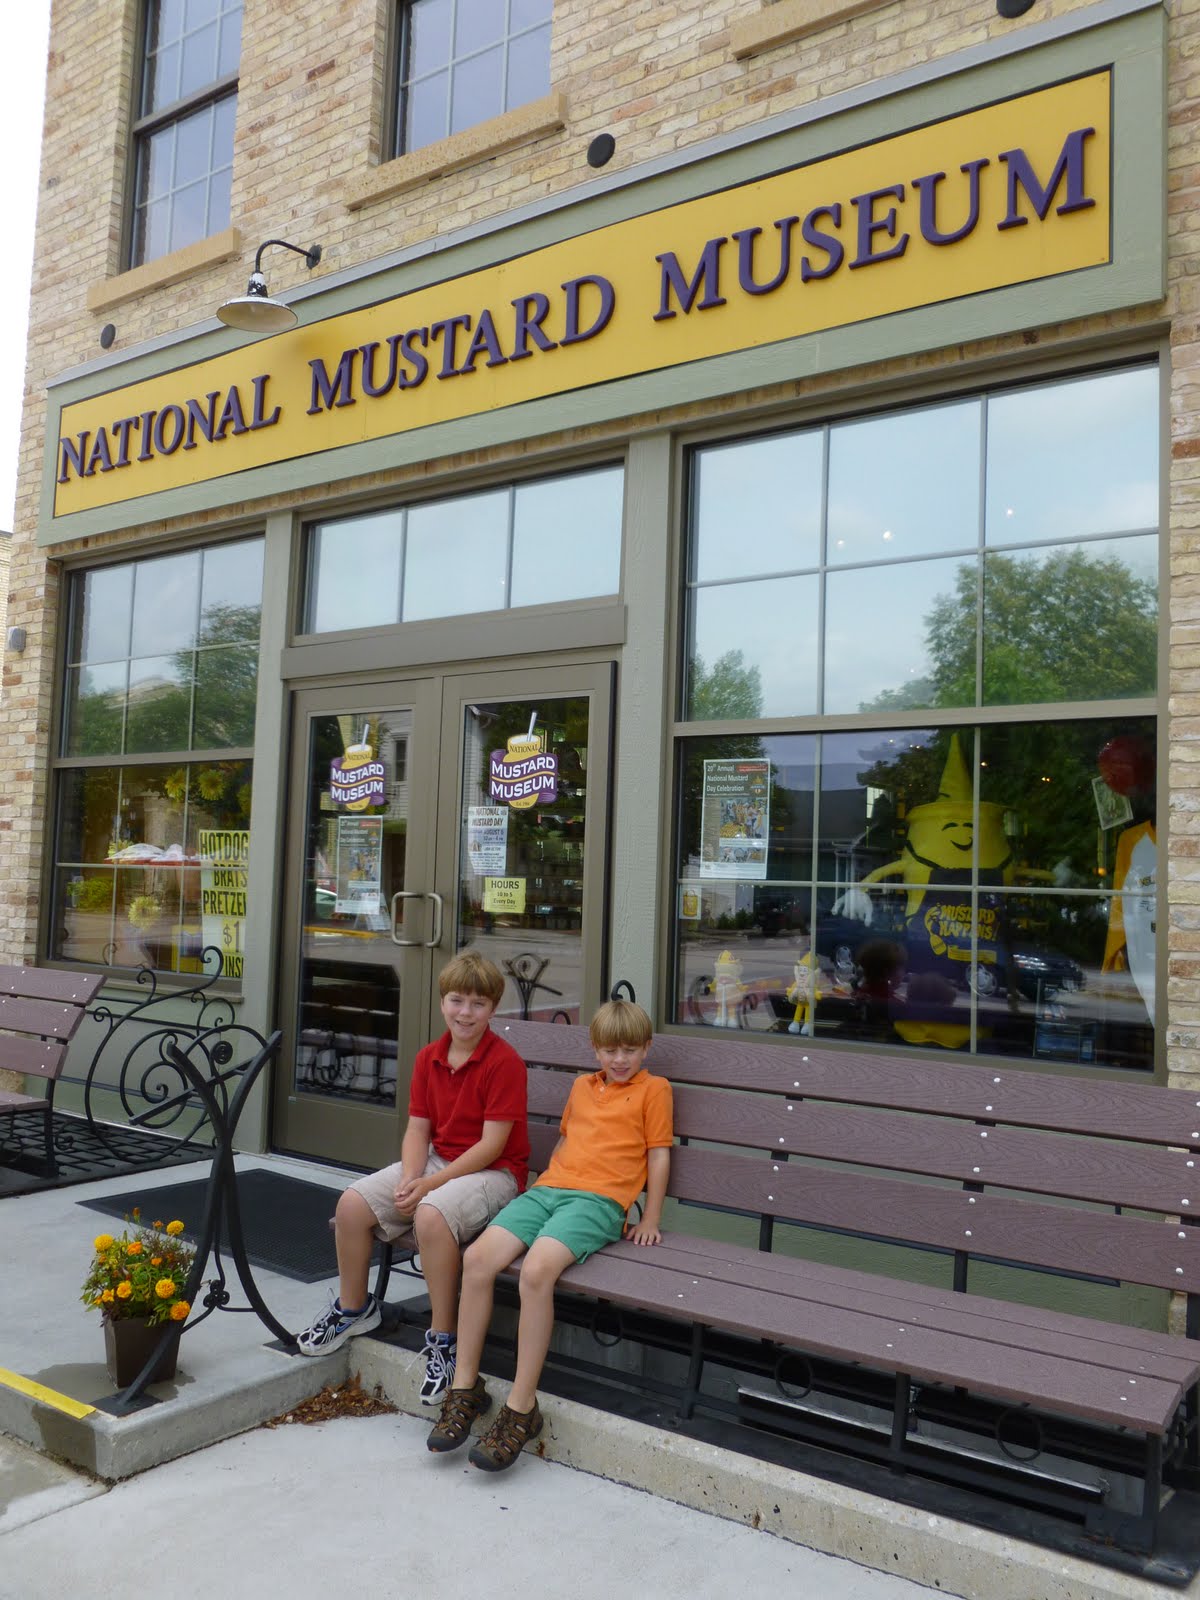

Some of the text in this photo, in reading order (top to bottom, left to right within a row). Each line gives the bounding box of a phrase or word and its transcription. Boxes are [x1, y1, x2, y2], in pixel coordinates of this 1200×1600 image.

[58, 127, 1096, 483] NATIONAL MUSTARD MUSEUM
[509, 744, 538, 753] NATIONAL
[331, 763, 384, 783] MUSTARD
[491, 757, 555, 778] MUSTARD
[331, 781, 383, 801] MUSEUM
[491, 776, 554, 798] MUSEUM
[493, 817, 504, 826] DAY
[213, 863, 248, 888] BRATS
[491, 880, 520, 889] HOURS
[940, 904, 996, 924] MUSTRD
